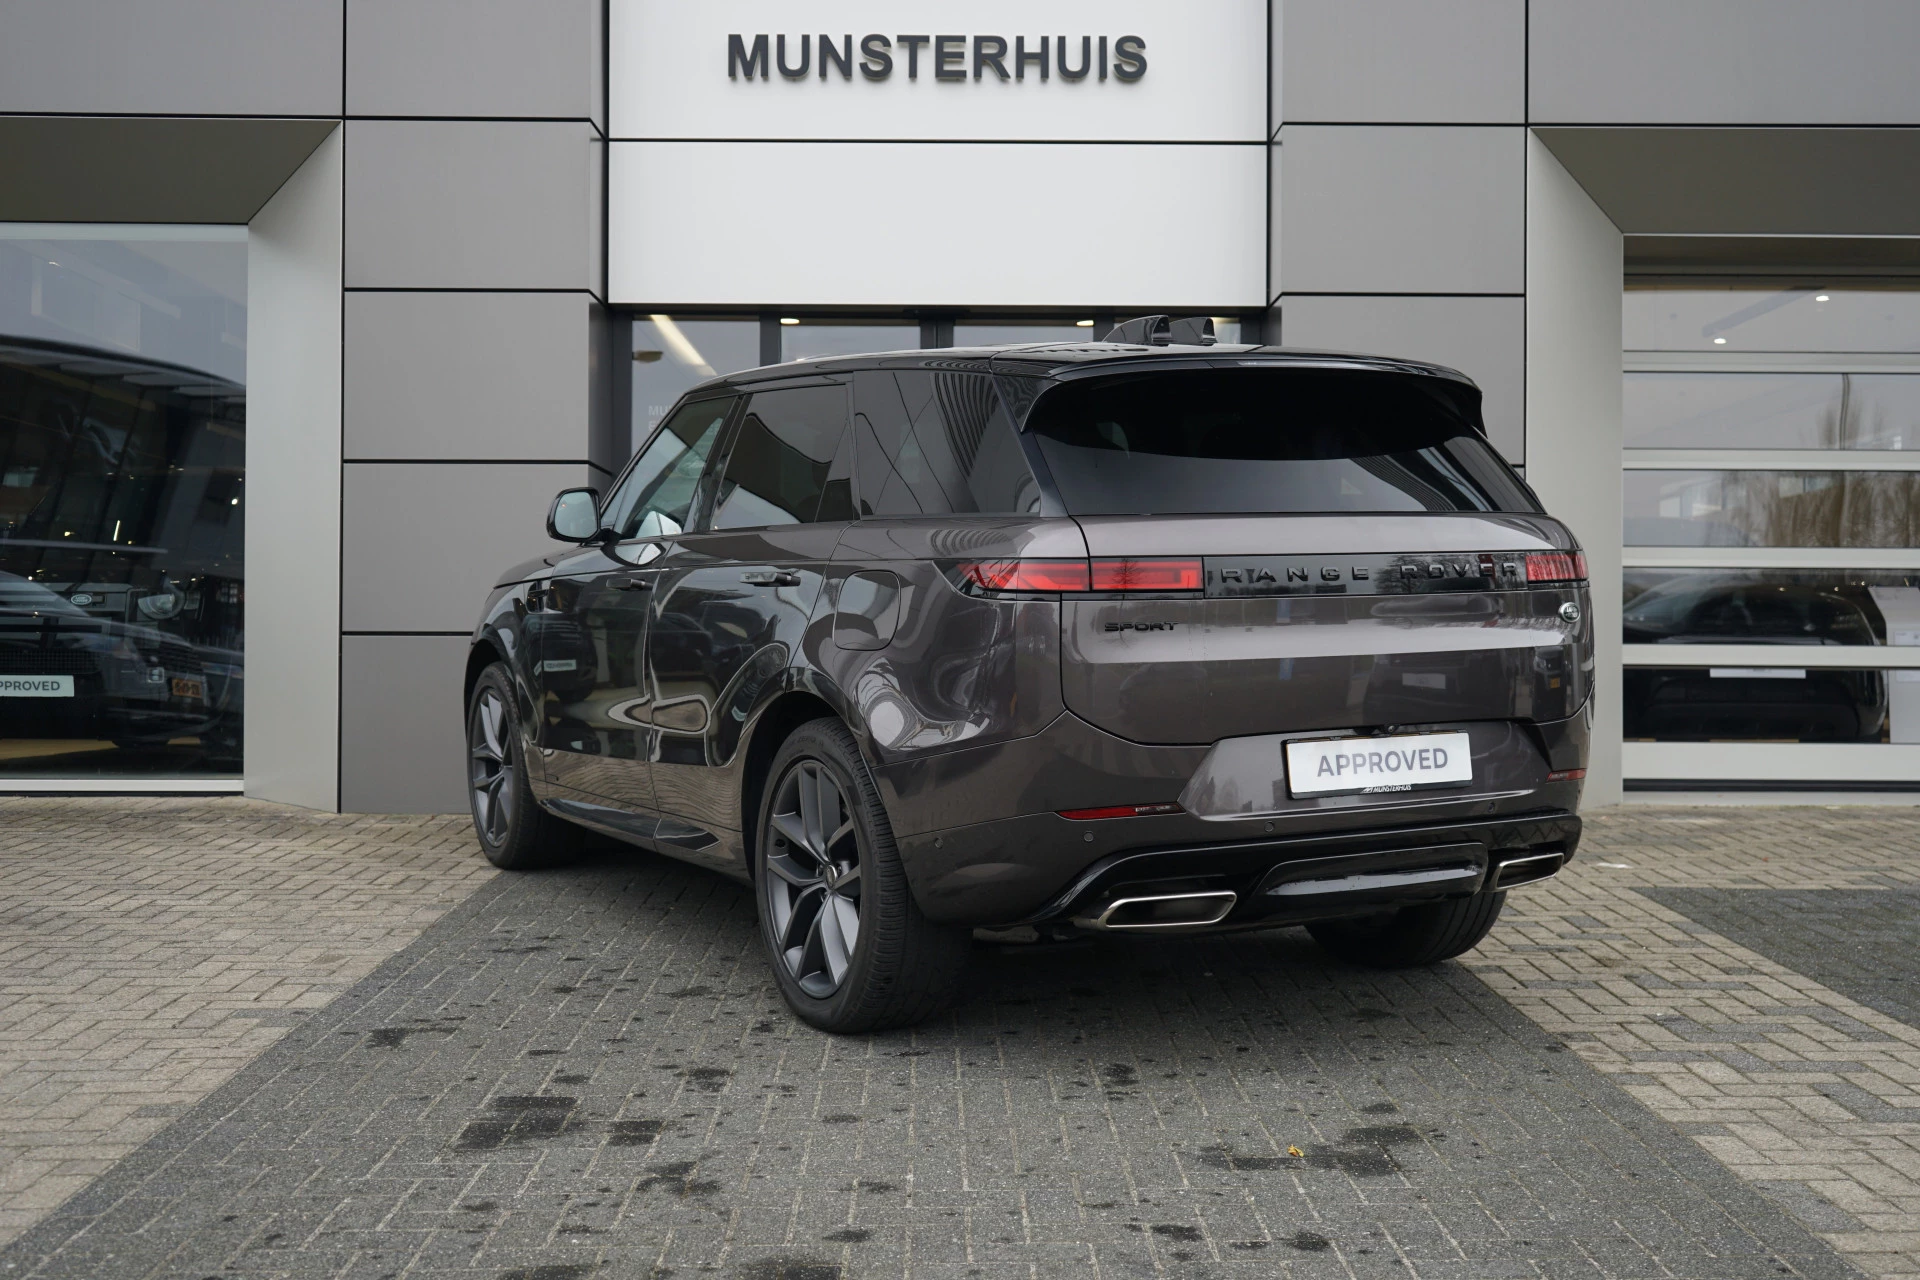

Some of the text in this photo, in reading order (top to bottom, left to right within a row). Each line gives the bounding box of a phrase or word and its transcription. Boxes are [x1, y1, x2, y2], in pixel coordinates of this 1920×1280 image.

[728, 34, 1148, 81] MUNSTERHUIS
[1221, 562, 1517, 583] RANGE ROVER
[1104, 622, 1180, 632] SPORT
[1317, 748, 1448, 777] APPROVED
